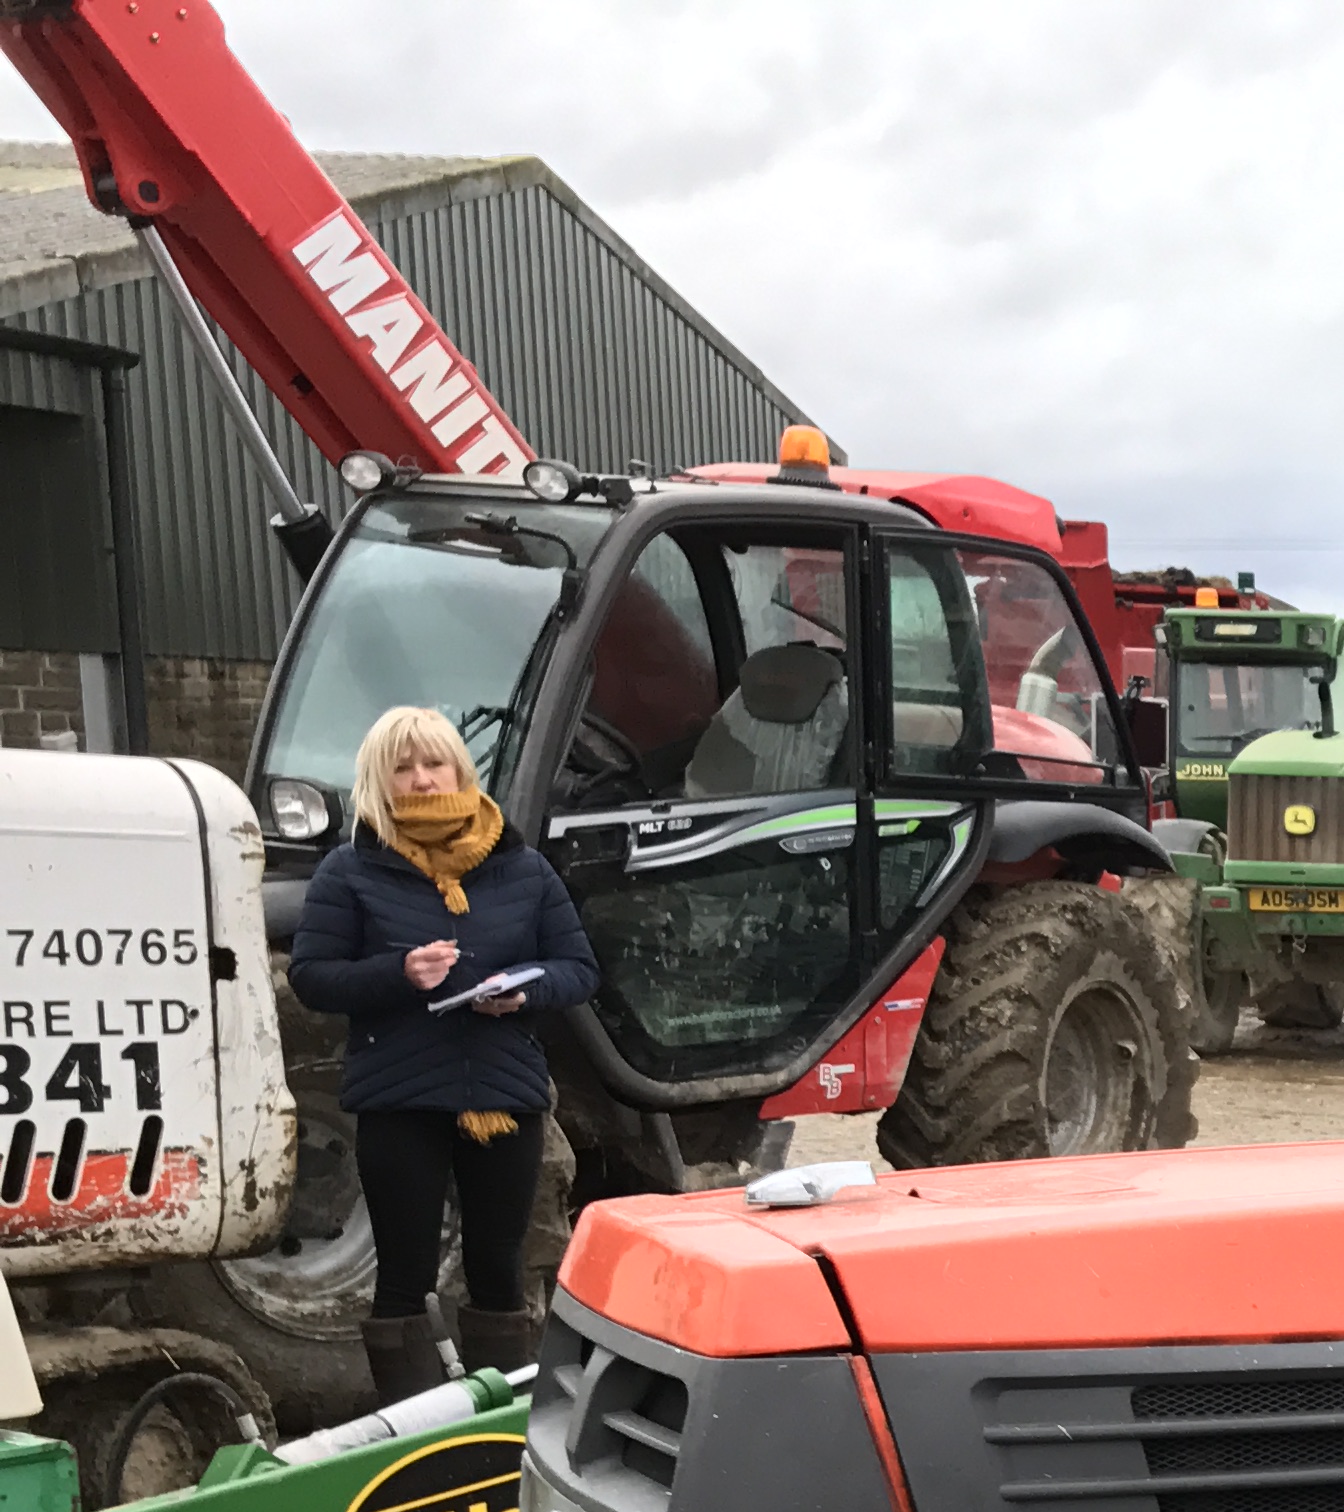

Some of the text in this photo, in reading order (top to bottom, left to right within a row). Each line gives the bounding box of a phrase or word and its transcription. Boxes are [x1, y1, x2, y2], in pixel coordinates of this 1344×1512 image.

[292, 213, 531, 480] MANIT
[1182, 763, 1224, 777] JOHN
[639, 820, 665, 834] MLT
[6, 928, 198, 967] 740765
[3, 999, 191, 1038] RE LTD
